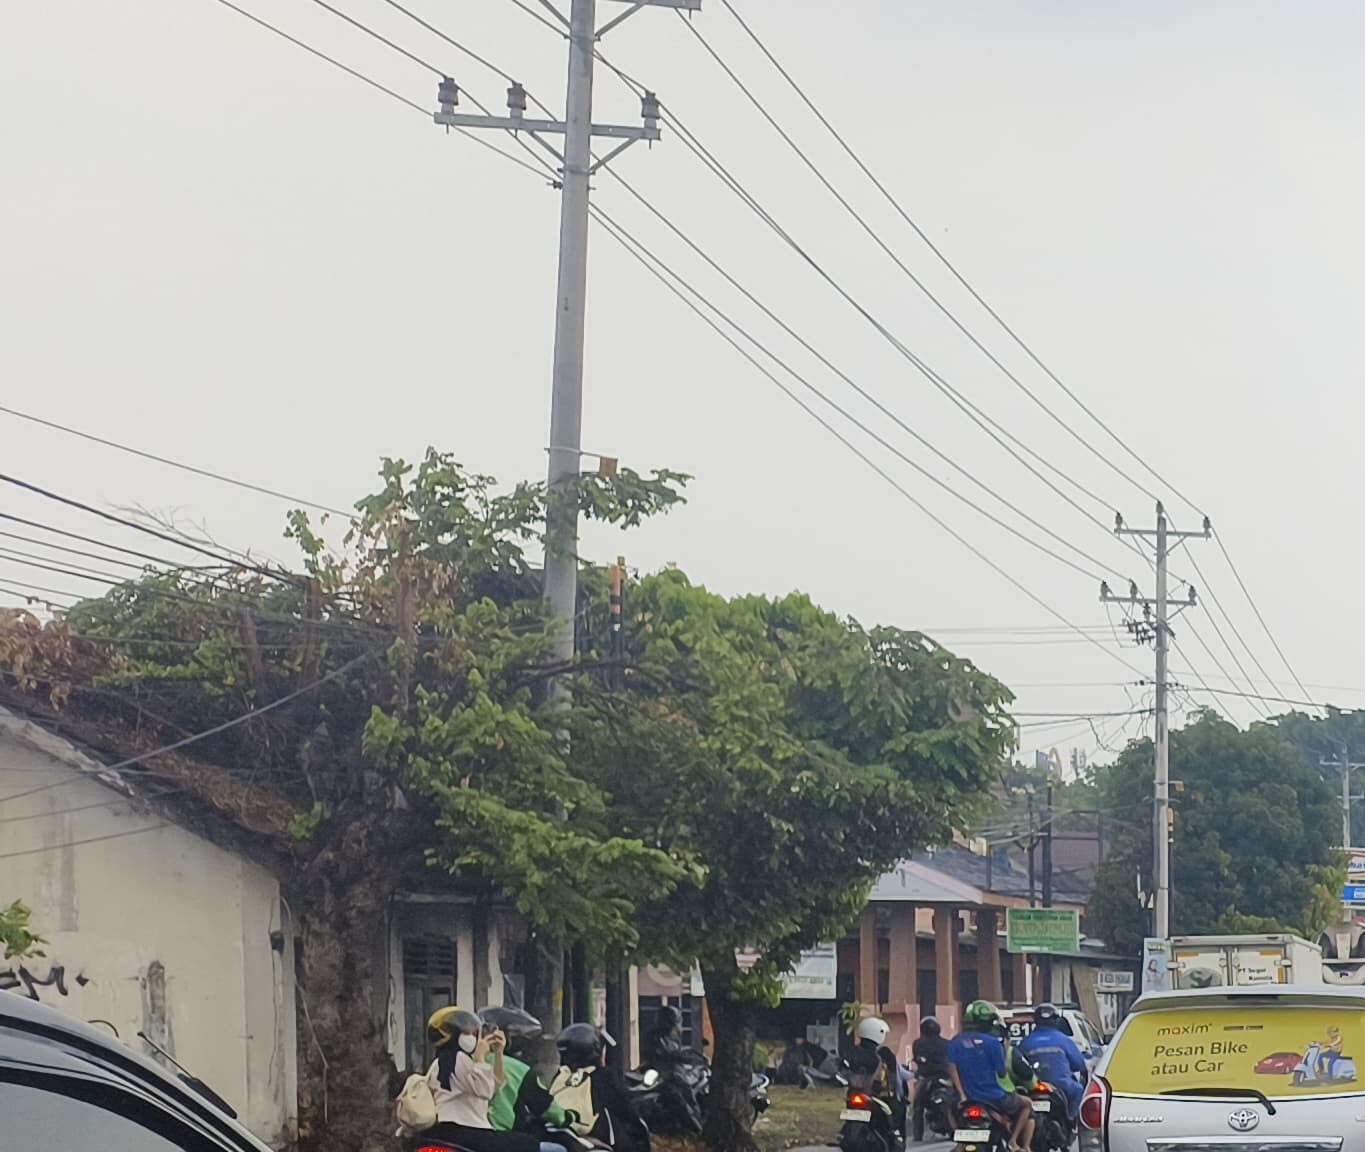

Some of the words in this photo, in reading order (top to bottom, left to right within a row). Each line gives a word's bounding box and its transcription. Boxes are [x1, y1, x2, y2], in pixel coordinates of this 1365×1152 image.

[1154, 1044, 1204, 1058] Pesan
[1210, 1041, 1248, 1055] Bike
[1151, 1062, 1188, 1075] atau
[1194, 1060, 1224, 1073] Car
